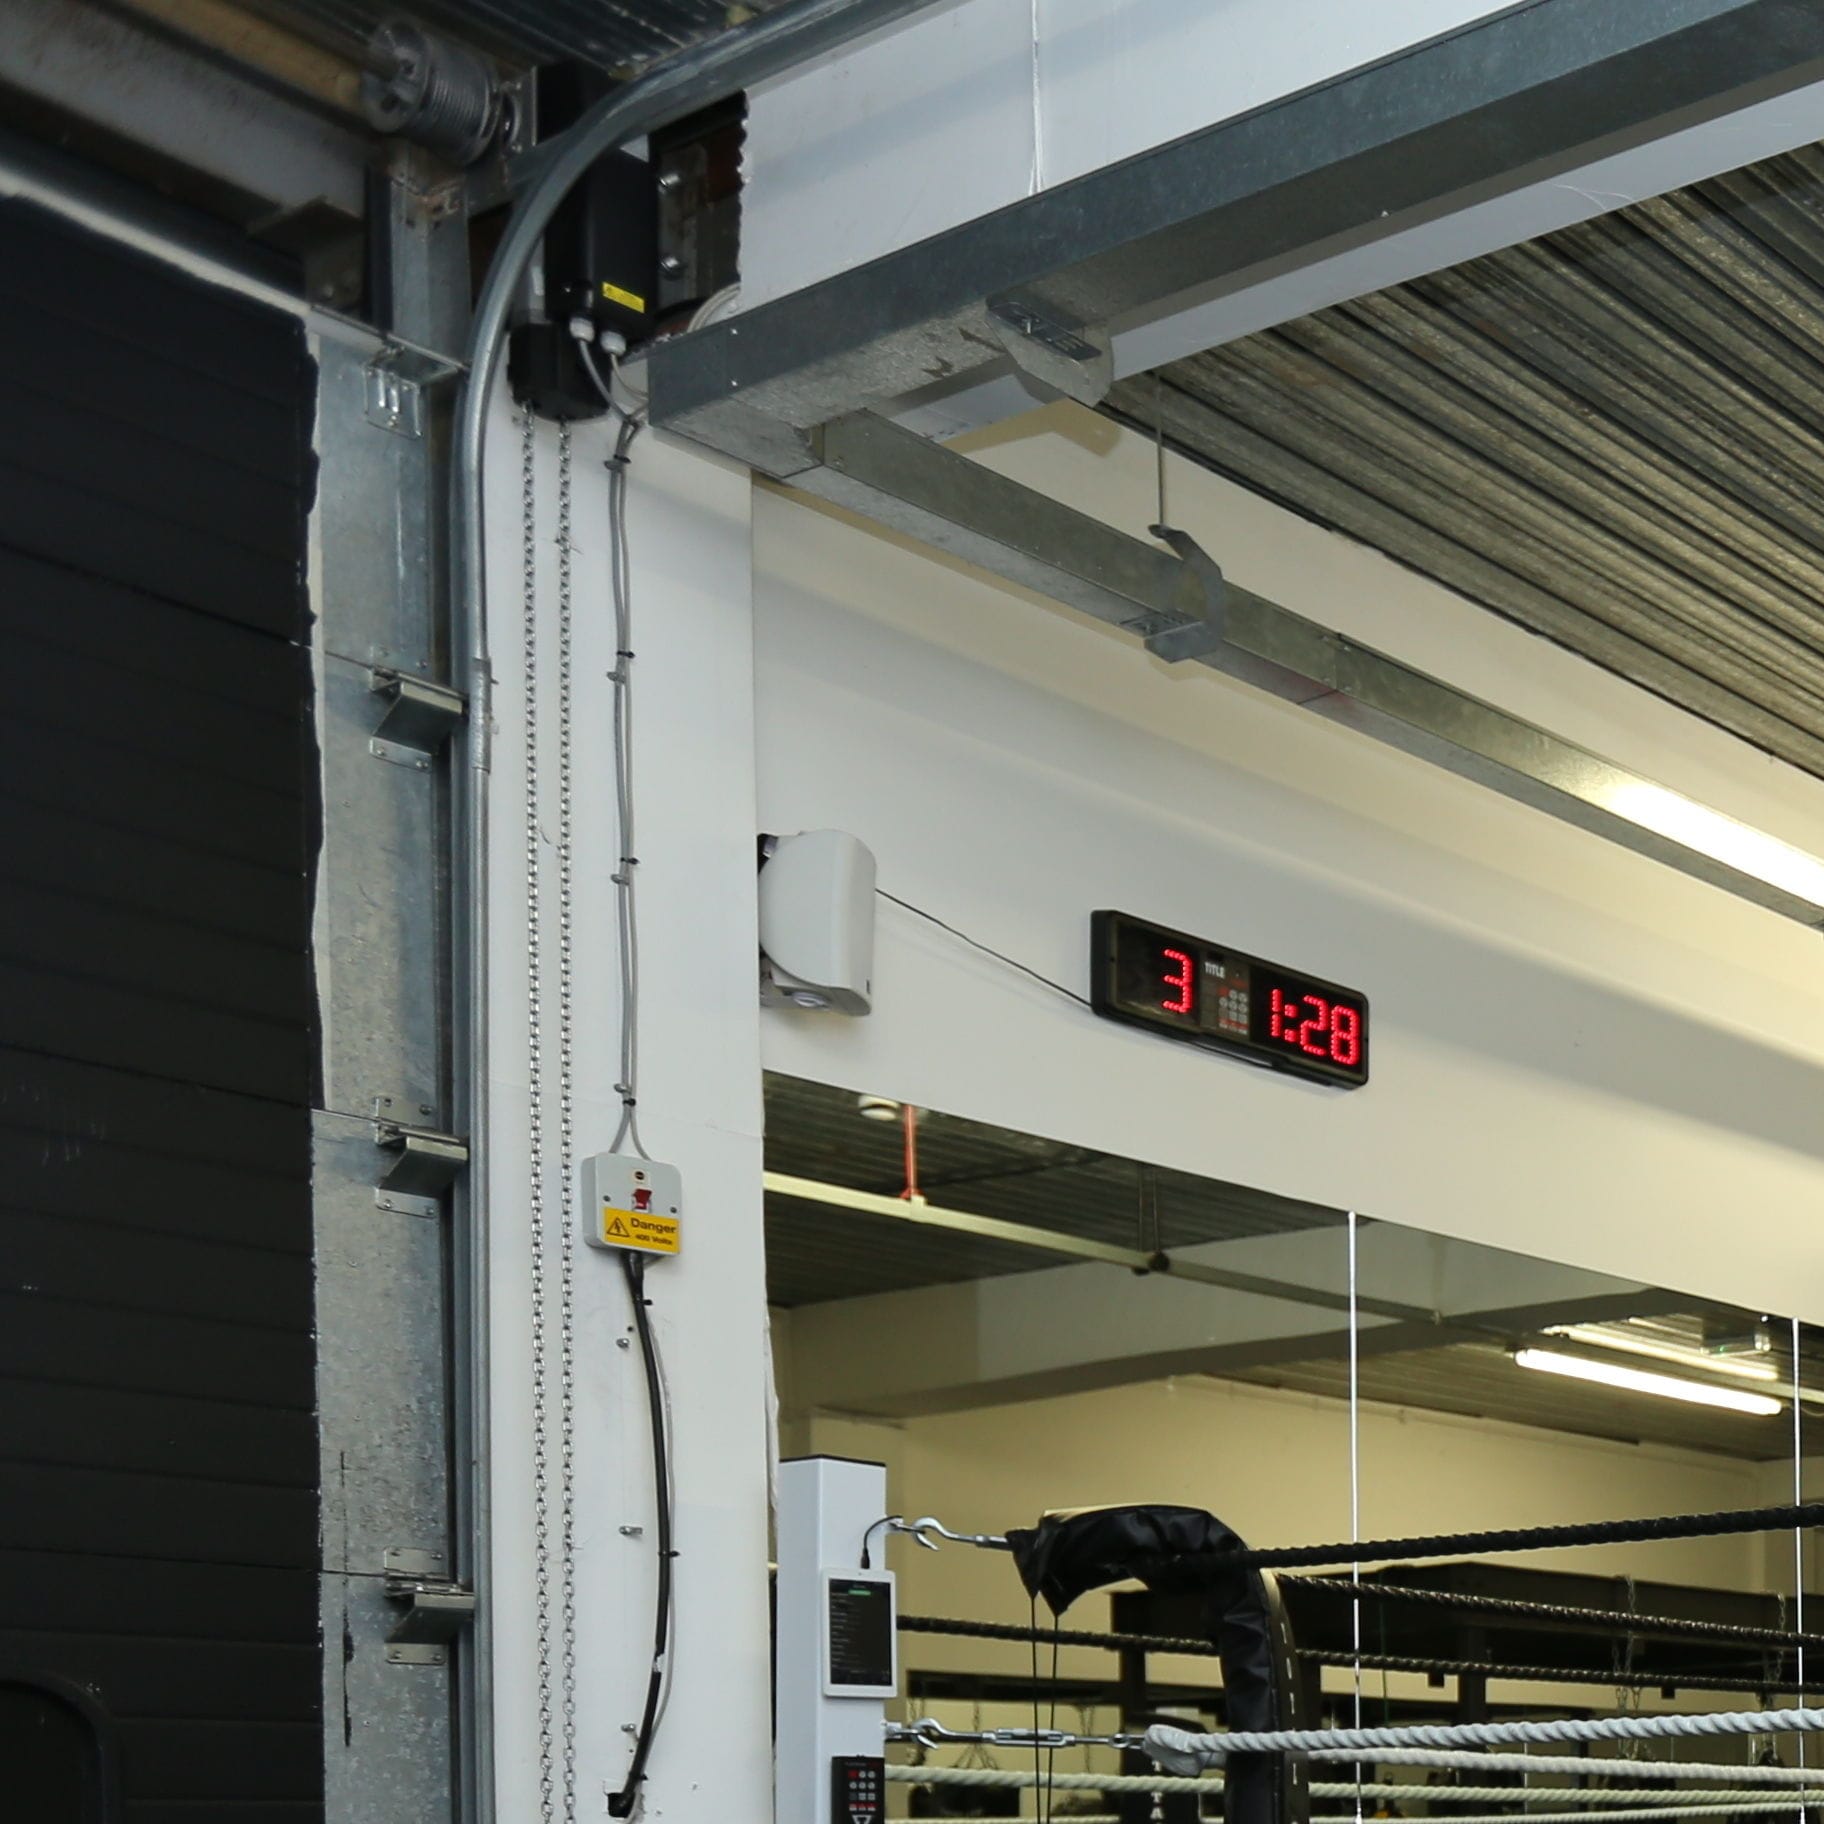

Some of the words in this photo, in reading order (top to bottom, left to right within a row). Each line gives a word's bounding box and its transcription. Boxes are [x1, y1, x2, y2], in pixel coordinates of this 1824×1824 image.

[1162, 948, 1194, 1014] 3
[1269, 988, 1361, 1066] 1:28
[630, 1217, 676, 1234] Danger
